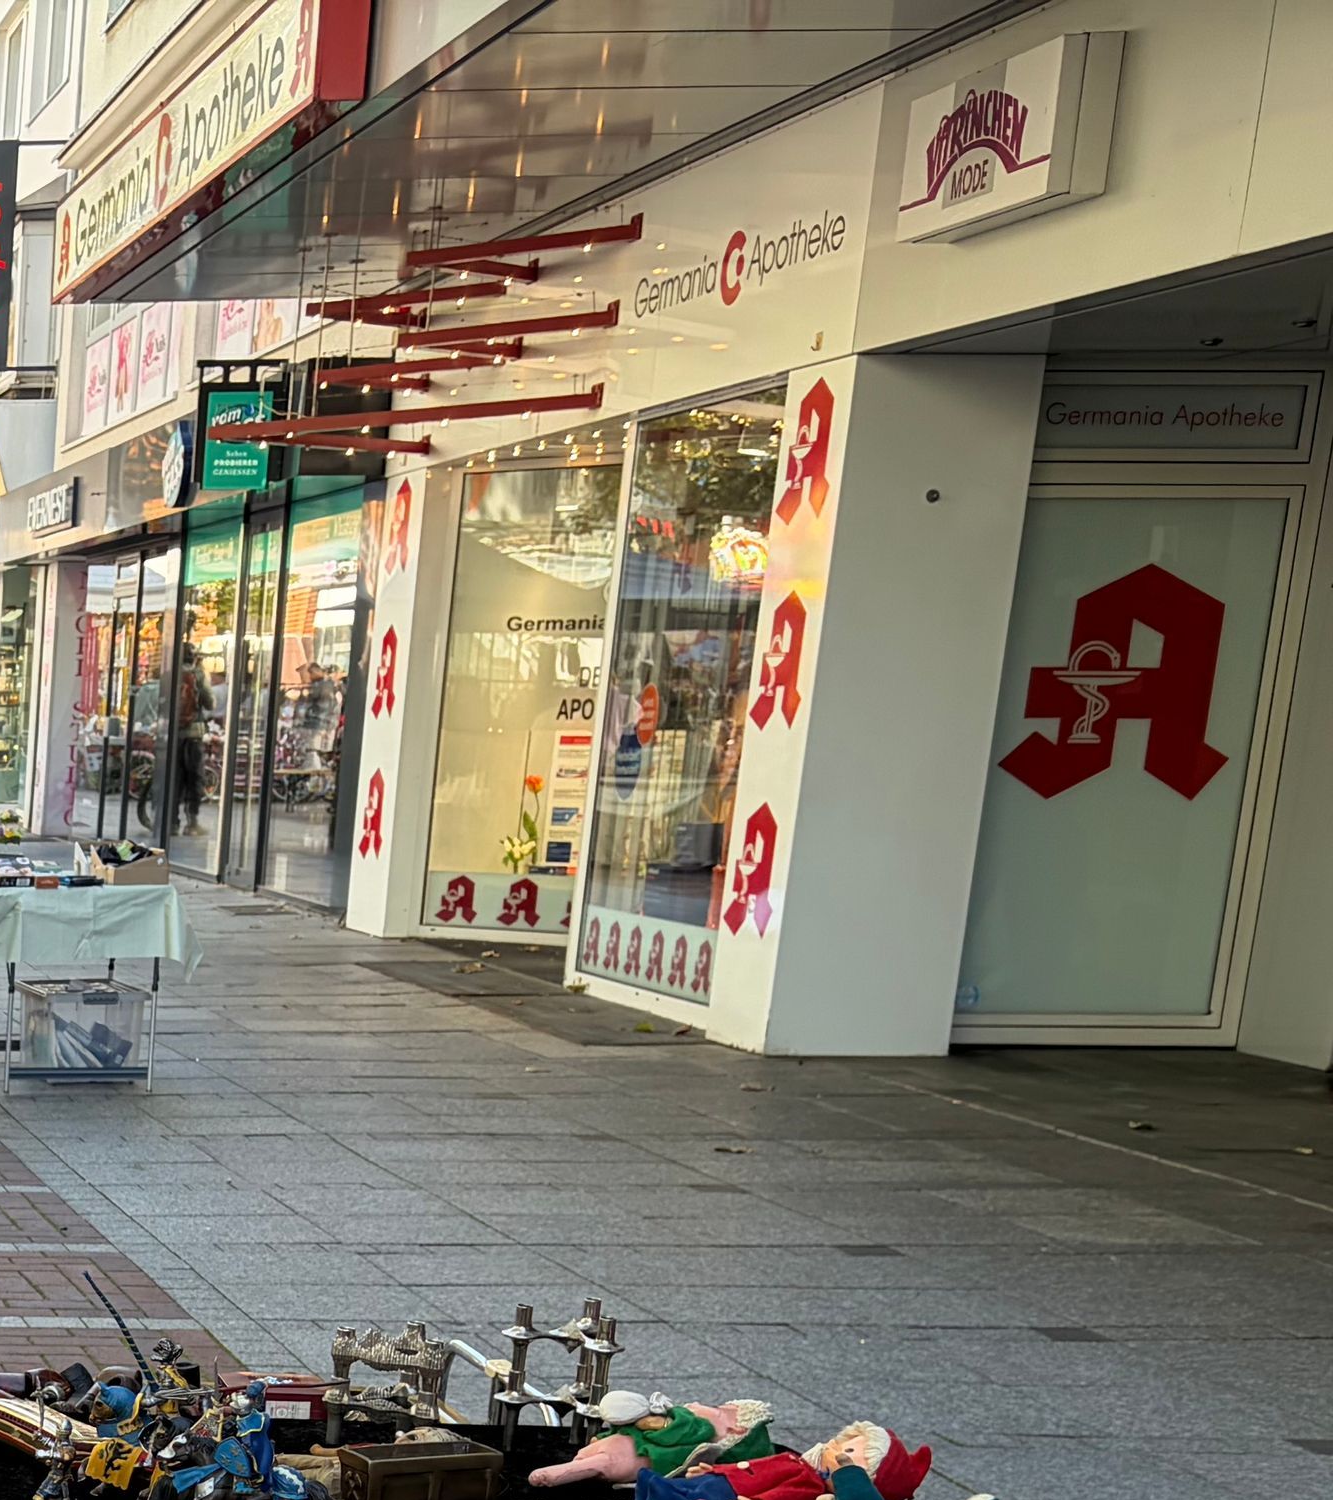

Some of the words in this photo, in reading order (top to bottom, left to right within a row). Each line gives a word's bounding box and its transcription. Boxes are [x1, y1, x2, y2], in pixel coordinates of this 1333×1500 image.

[73, 147, 153, 264] Germania
[177, 33, 286, 186] Apotheke
[926, 88, 1030, 195] VITRINCHEN
[950, 159, 989, 201] MODE
[634, 259, 719, 319] Germania
[747, 209, 846, 288] Apotheke
[1045, 401, 1165, 430] Germania
[1175, 403, 1285, 433] Apotheke
[213, 468, 258, 476] GENIESSEN
[507, 616, 605, 633] Germania
